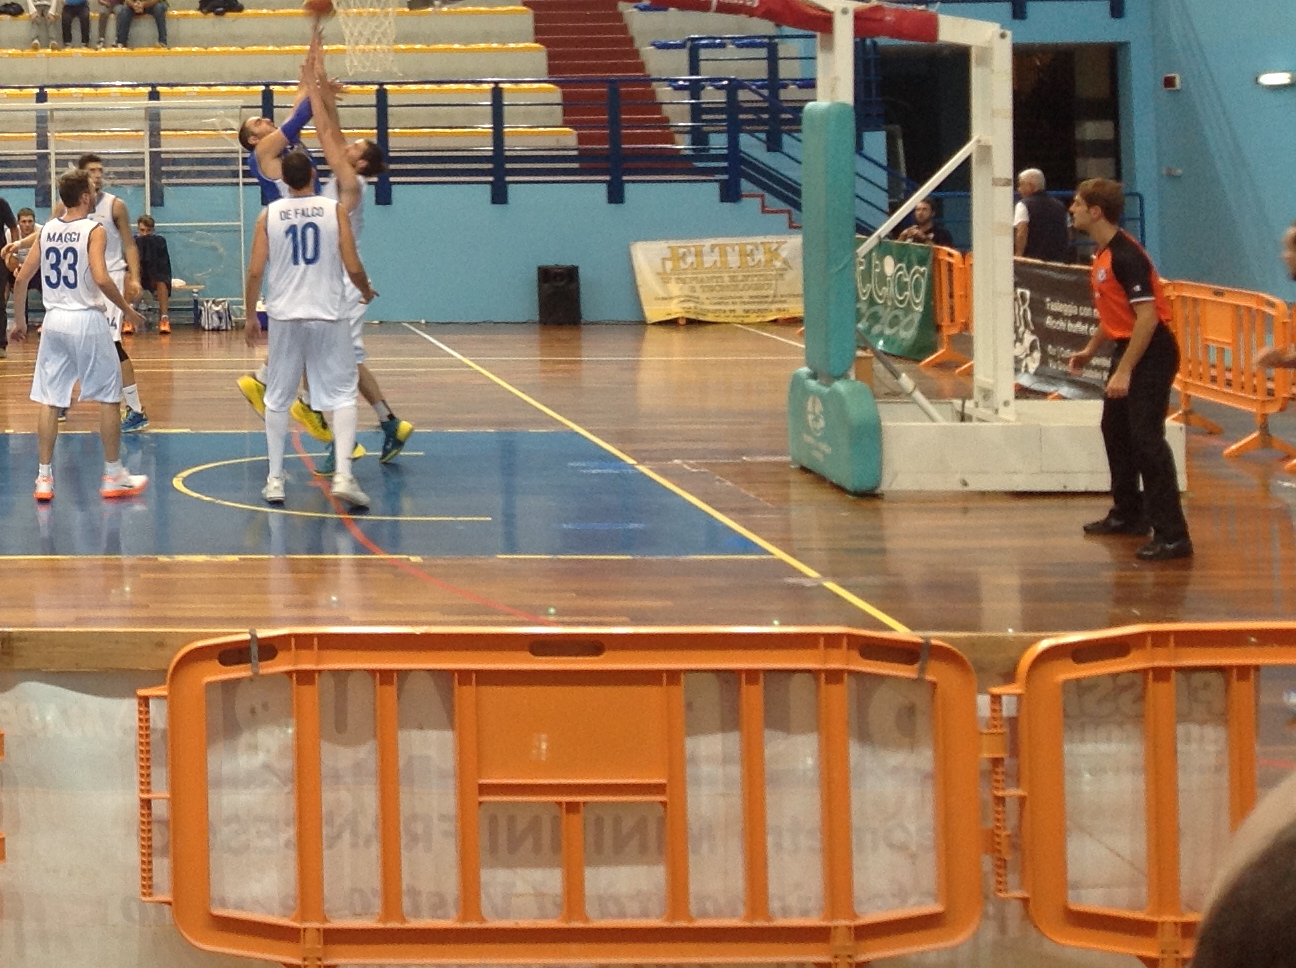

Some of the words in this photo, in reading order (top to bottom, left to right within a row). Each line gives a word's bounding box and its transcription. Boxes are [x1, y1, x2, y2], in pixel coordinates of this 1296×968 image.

[279, 209, 293, 221] DE
[285, 221, 321, 266] 10
[666, 240, 793, 272] ELTEK
[44, 246, 79, 290] 33
[856, 251, 929, 312] ttica
